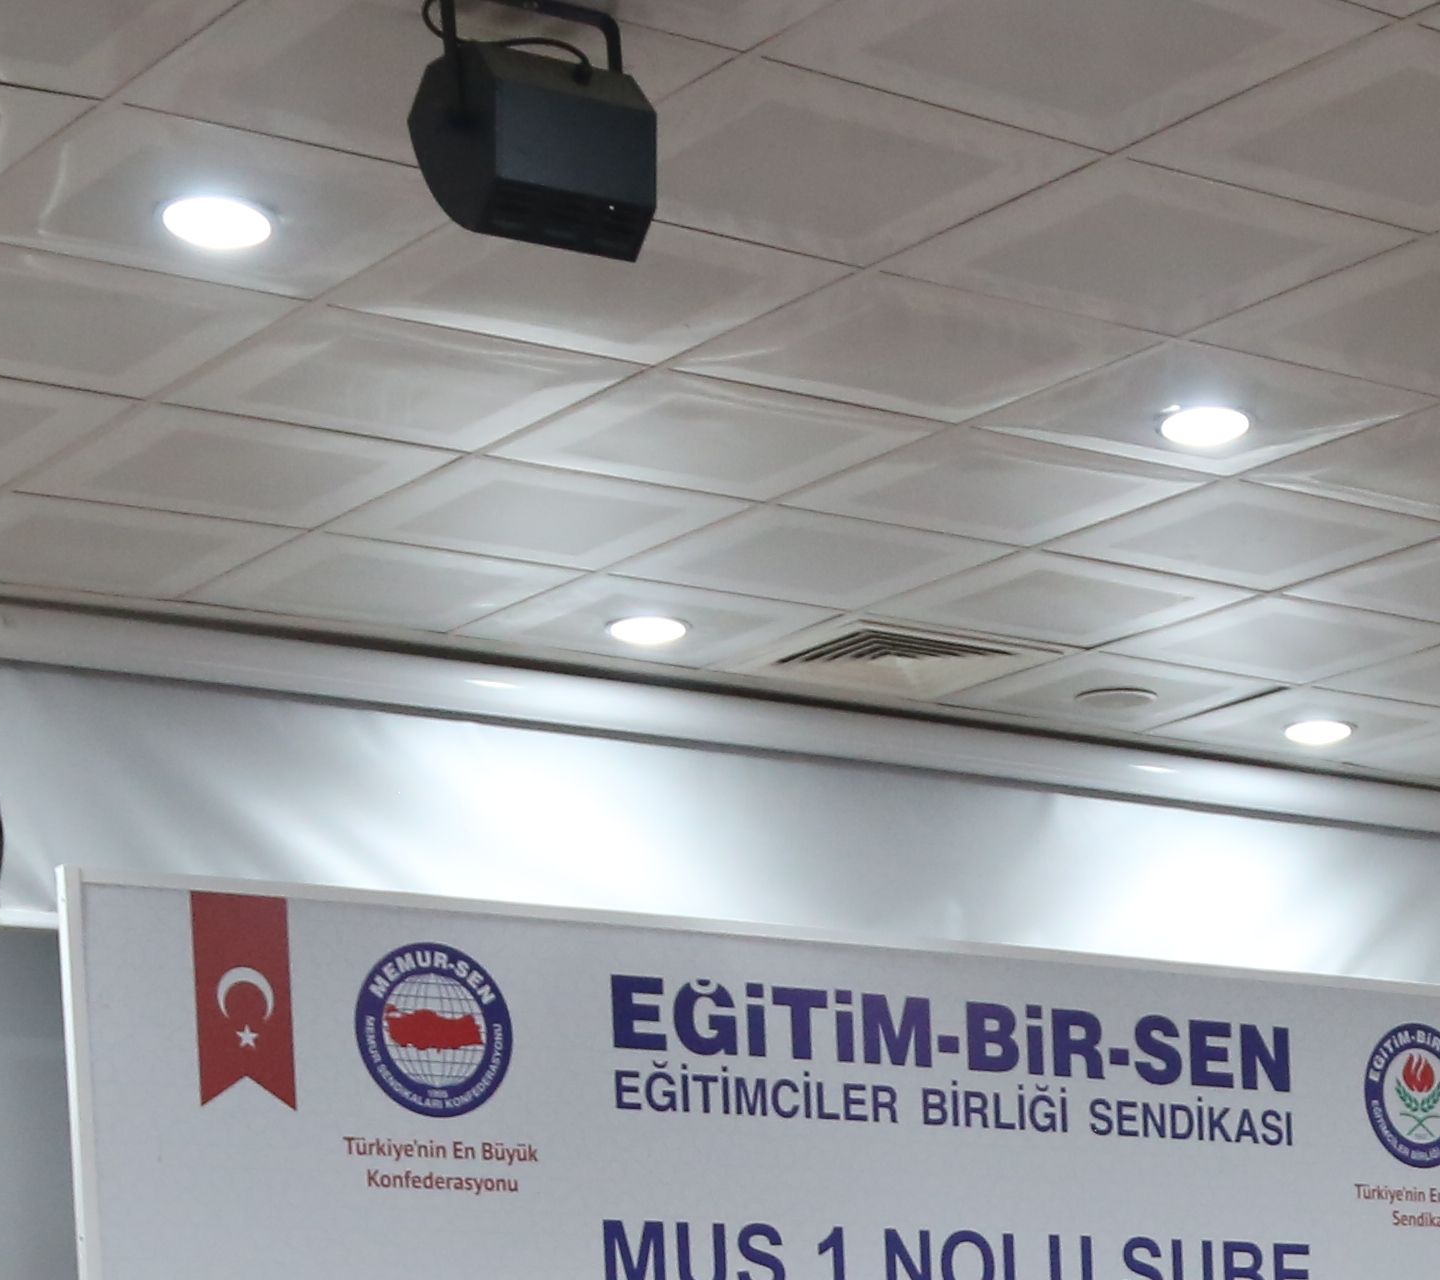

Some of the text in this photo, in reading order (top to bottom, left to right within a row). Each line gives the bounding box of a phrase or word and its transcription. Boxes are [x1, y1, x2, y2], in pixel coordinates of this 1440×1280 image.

[368, 950, 496, 1004] MEMUR-SEN
[614, 1060, 1293, 1146] EĞİTİMCİLER BİRLİĞİ SENDİKASI
[343, 1136, 539, 1165] Türkiye'nin En Büyük
[367, 1169, 518, 1195] Konfederasyonu
[1354, 1183, 1426, 1204] Türkiye'nin
